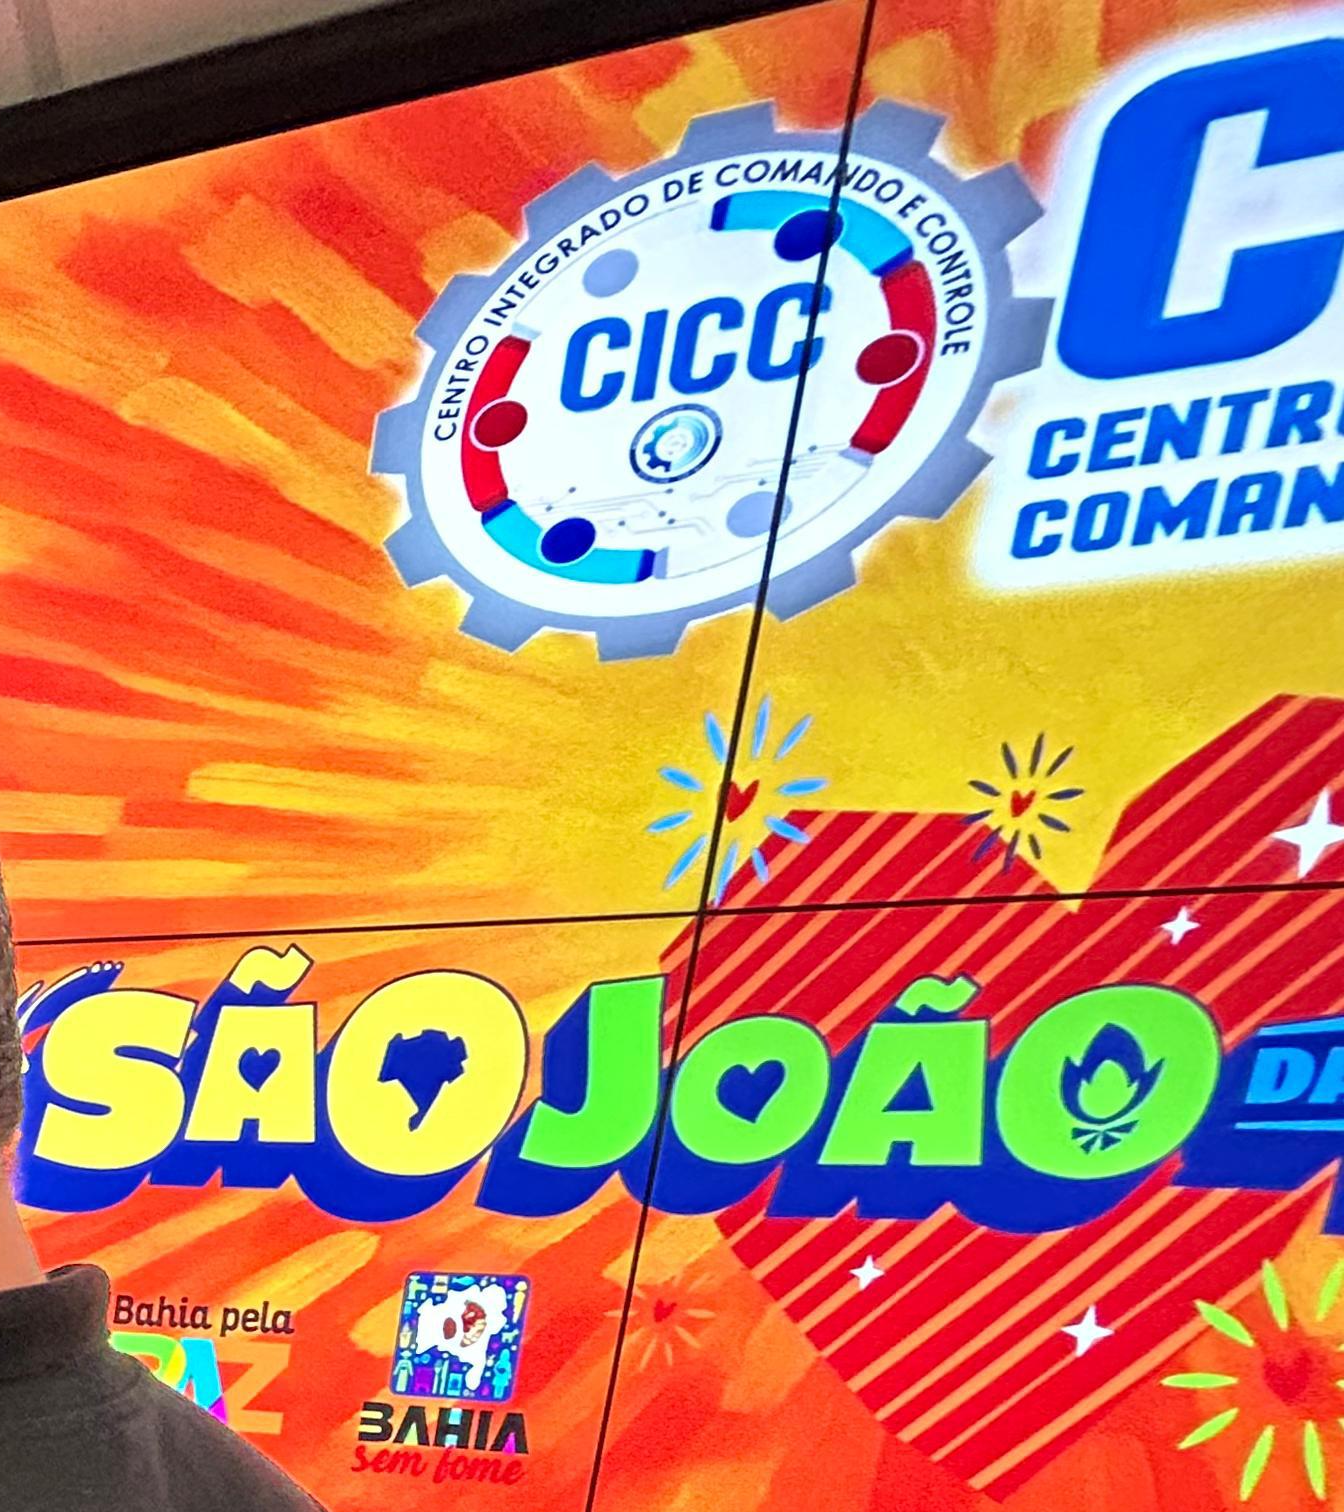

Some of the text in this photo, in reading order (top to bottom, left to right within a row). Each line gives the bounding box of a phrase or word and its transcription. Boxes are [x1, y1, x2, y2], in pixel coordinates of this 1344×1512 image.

[433, 159, 973, 442] CENTRO INTEGRADO DE COMANDO E CONTROLE
[559, 281, 833, 413] CICC
[1027, 380, 1344, 480] CENTR
[32, 942, 1222, 1180] SÃO JOÃO
[112, 1294, 295, 1338] Bahia pela
[350, 1444, 527, 1486] sem fome
[357, 1400, 529, 1455] BAHIA
